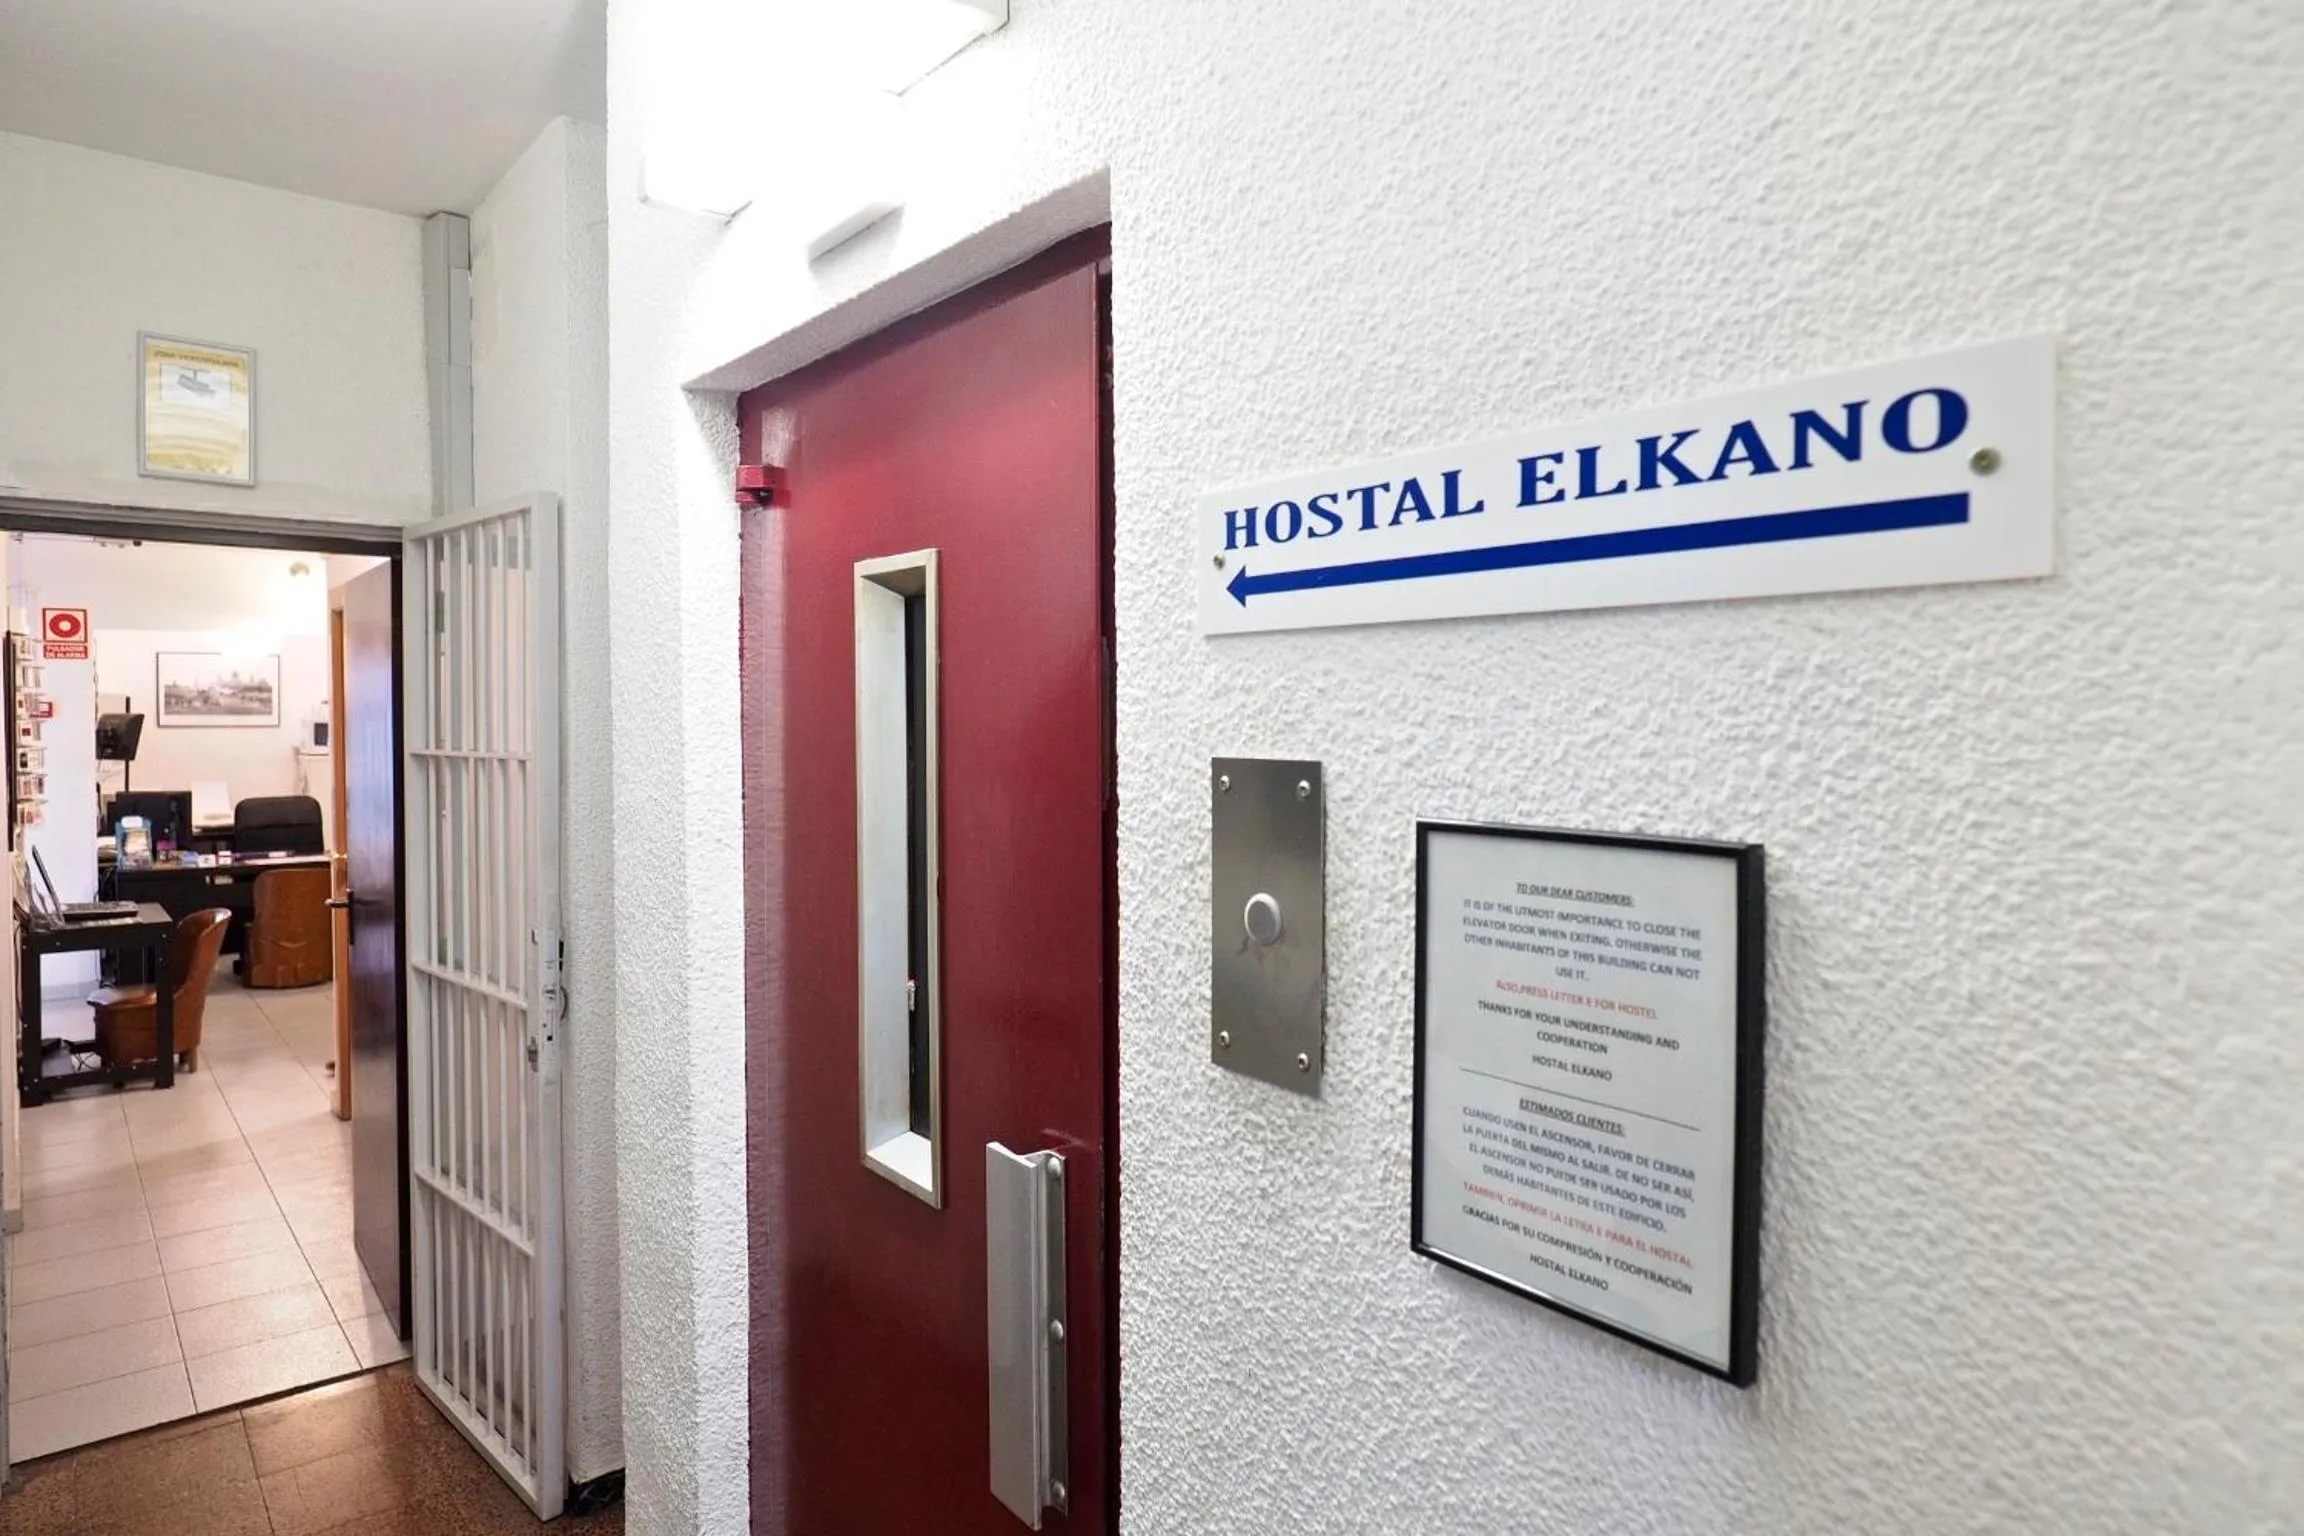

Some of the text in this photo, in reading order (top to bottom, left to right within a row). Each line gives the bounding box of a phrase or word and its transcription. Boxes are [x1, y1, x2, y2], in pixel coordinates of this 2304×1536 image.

[1223, 386, 1970, 551] HOSTAL ELKANO
[1516, 883, 1528, 894] TO
[1530, 884, 1548, 896] OUR
[1550, 886, 1573, 899] DEAR
[1463, 916, 1507, 931] ELEVATOR
[1508, 922, 1535, 935] DOOR
[1537, 927, 1567, 940] WHEN
[1615, 938, 1677, 957] OTHERWISE
[1680, 947, 1702, 961] THE
[1473, 900, 1481, 910] IS
[1483, 901, 1494, 911] OF
[1497, 902, 1513, 914] THE
[1515, 905, 1554, 919] UTMOST
[1557, 911, 1624, 930] IMPORTANCE
[1626, 920, 1642, 932] TO
[1643, 922, 1676, 937] CLOSE
[1680, 927, 1702, 941] THE
[1464, 933, 1701, 981] OTHER INHABITANTS OF THIS BUILDING CAN NOT
[1556, 966, 1574, 980] USE
[1550, 988, 1583, 1005] LETTER
[1594, 998, 1615, 1011] FOR
[1478, 1000, 1681, 1051] THANKS FOR YOUR UNDERSTANDING AND
[1536, 1031, 1609, 1055] COOPERATION
[1532, 1054, 1613, 1082] HOSTAL ELKANO
[1463, 1106, 1501, 1125] CUANDO
[1503, 1117, 1527, 1133] USEN
[1528, 1124, 1540, 1138] EL
[1598, 1144, 1634, 1163] FAVOR
[1635, 1154, 1650, 1169] DE
[1652, 1160, 1696, 1183] CERRAR
[1463, 1122, 1474, 1134] LA
[1475, 1127, 1510, 1146] PUERTA
[1511, 1137, 1529, 1152] DEL
[1530, 1143, 1566, 1164] MISMO
[1567, 1154, 1581, 1168] AL
[1615, 1168, 1630, 1182] DE
[1631, 1173, 1649, 1187] NO
[1651, 1178, 1672, 1195] SER
[1481, 1146, 1527, 1168] ASCENSOR
[1529, 1160, 1545, 1174] NO
[1546, 1166, 1578, 1185] PUEDE
[1579, 1176, 1599, 1191] SER
[1600, 1182, 1638, 1204] USADO
[1639, 1194, 1663, 1212] POR
[1665, 1203, 1687, 1220] LOS
[1517, 1174, 1575, 1203] HABITANTES
[1576, 1194, 1591, 1208] DE
[1592, 1200, 1617, 1217] ESTE
[1462, 1205, 1500, 1226] GRACIAS
[1502, 1218, 1521, 1234] POR
[1522, 1226, 1535, 1240] SU
[1605, 1255, 1612, 1267] Y
[1550, 1209, 1563, 1223] LA
[1604, 1228, 1634, 1248] PARA
[1635, 1239, 1648, 1253] EL
[1530, 1254, 1609, 1291] HOSTAL ELKANO
